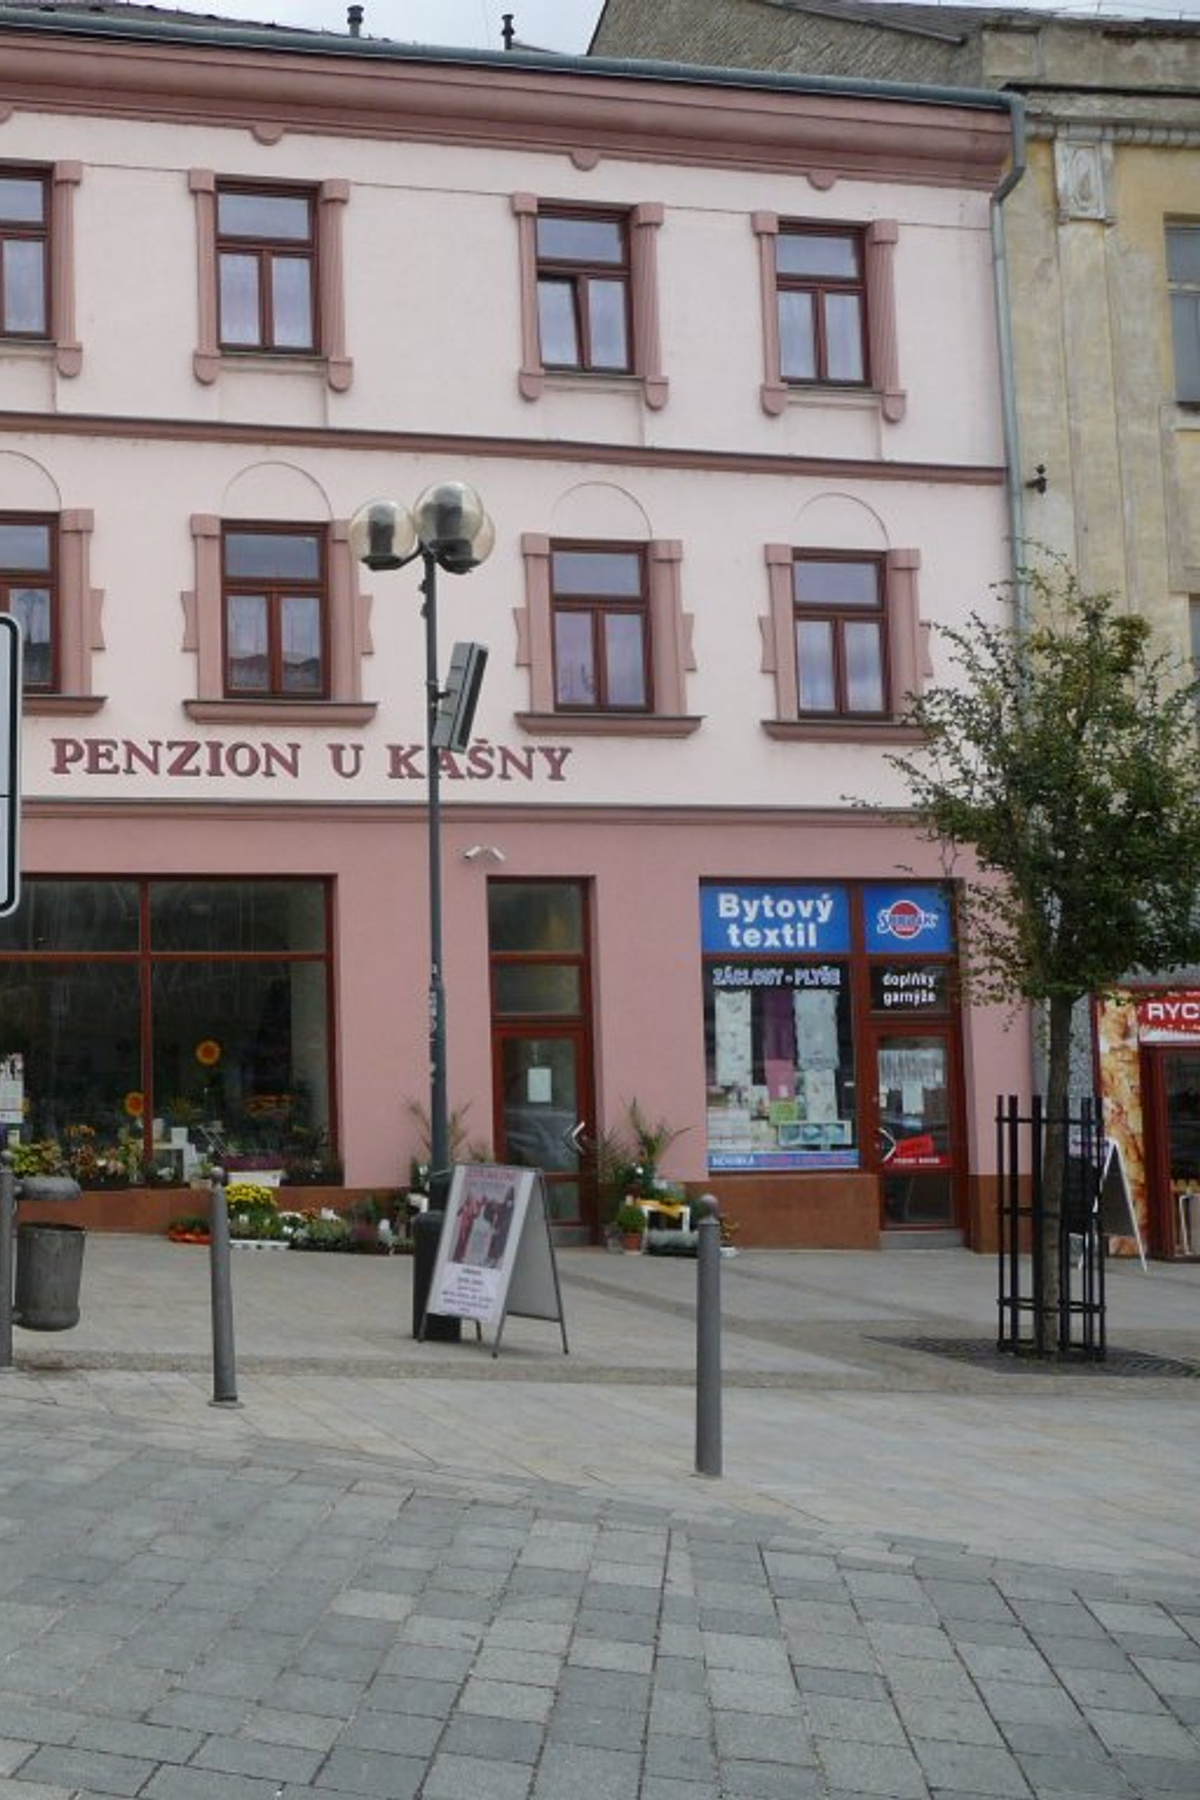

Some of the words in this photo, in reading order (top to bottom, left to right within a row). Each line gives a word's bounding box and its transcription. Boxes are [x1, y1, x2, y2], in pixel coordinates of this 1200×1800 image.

[50, 738, 301, 778] PENZION
[327, 743, 364, 779] U
[386, 738, 572, 781] KAŠNY
[718, 893, 833, 923] Bytový
[727, 923, 817, 948] textil
[883, 972, 936, 988] doplňky
[883, 989, 937, 1006] garnýže
